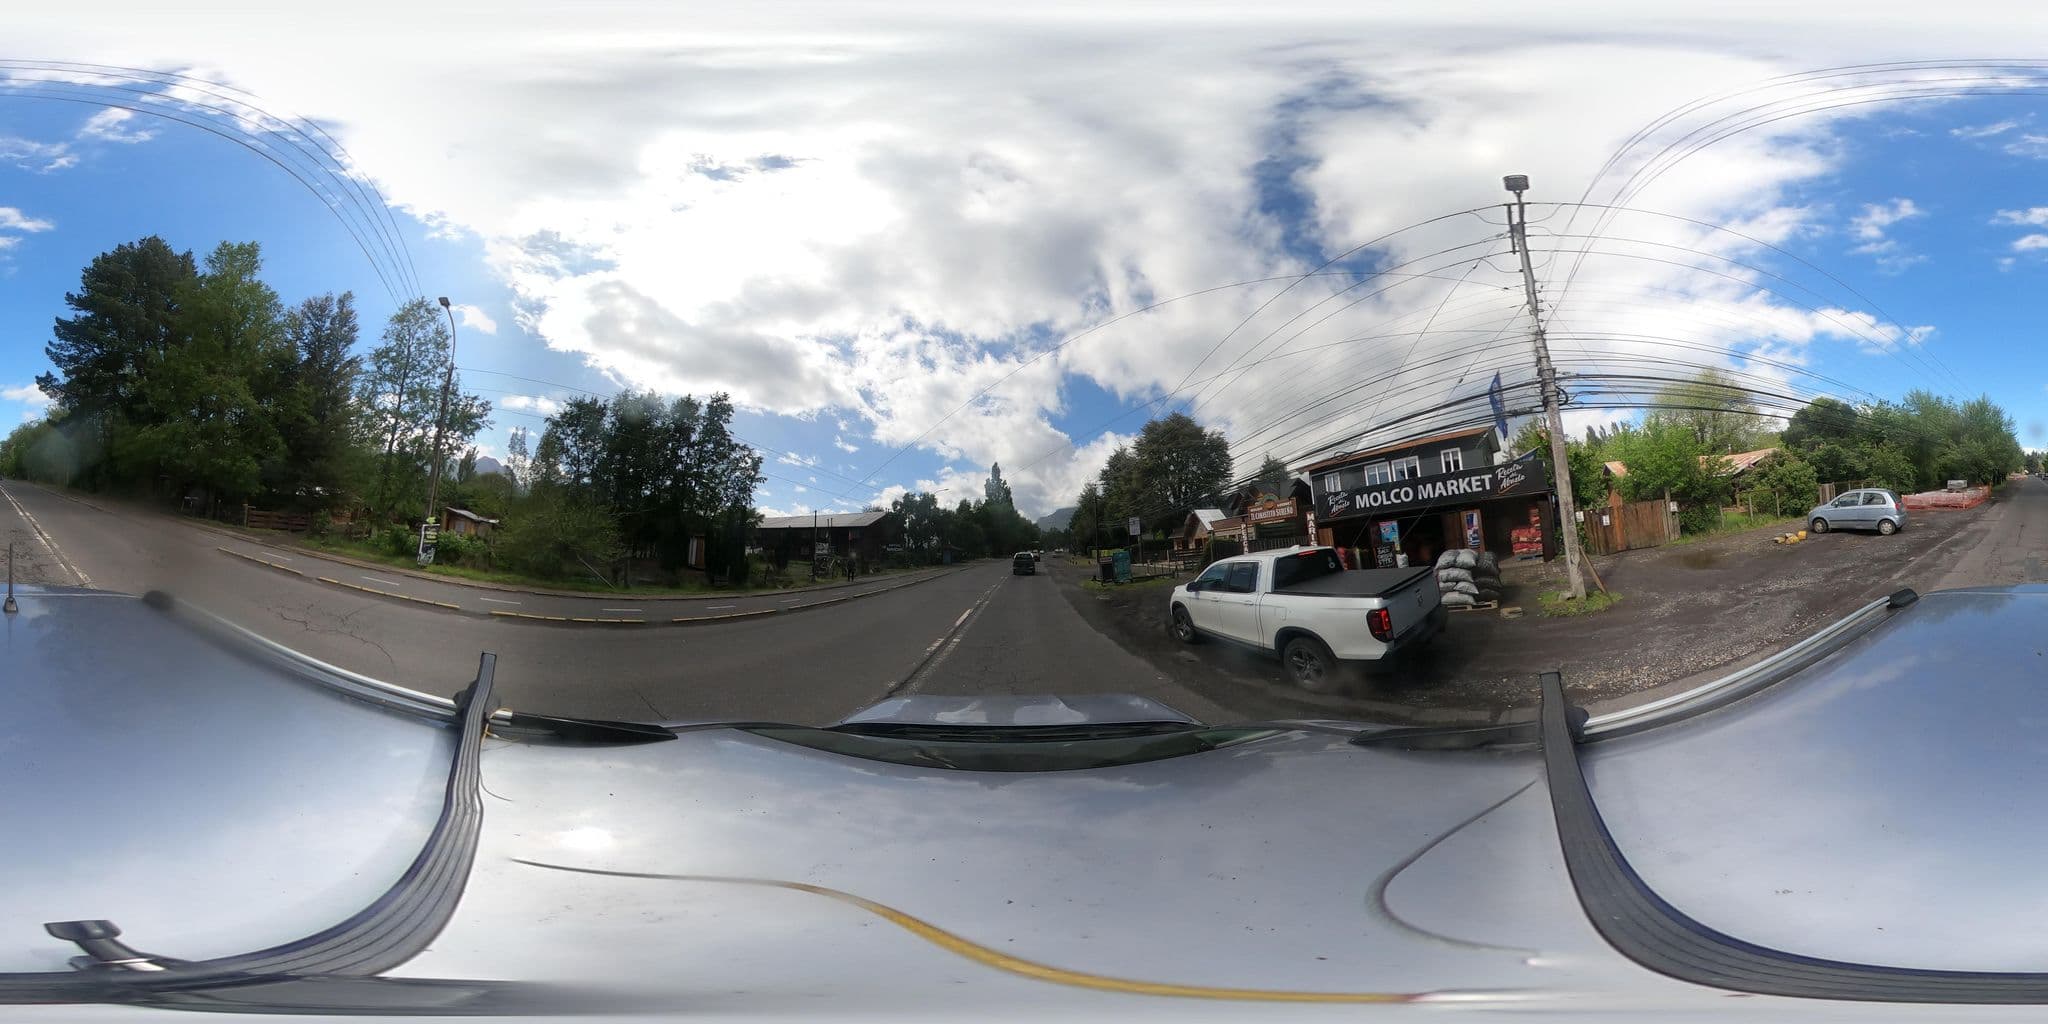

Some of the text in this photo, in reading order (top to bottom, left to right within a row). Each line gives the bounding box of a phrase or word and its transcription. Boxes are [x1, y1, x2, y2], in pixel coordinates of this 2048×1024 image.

[1495, 463, 1523, 480] Receta
[1355, 474, 1493, 509] MOLCO MARKET
